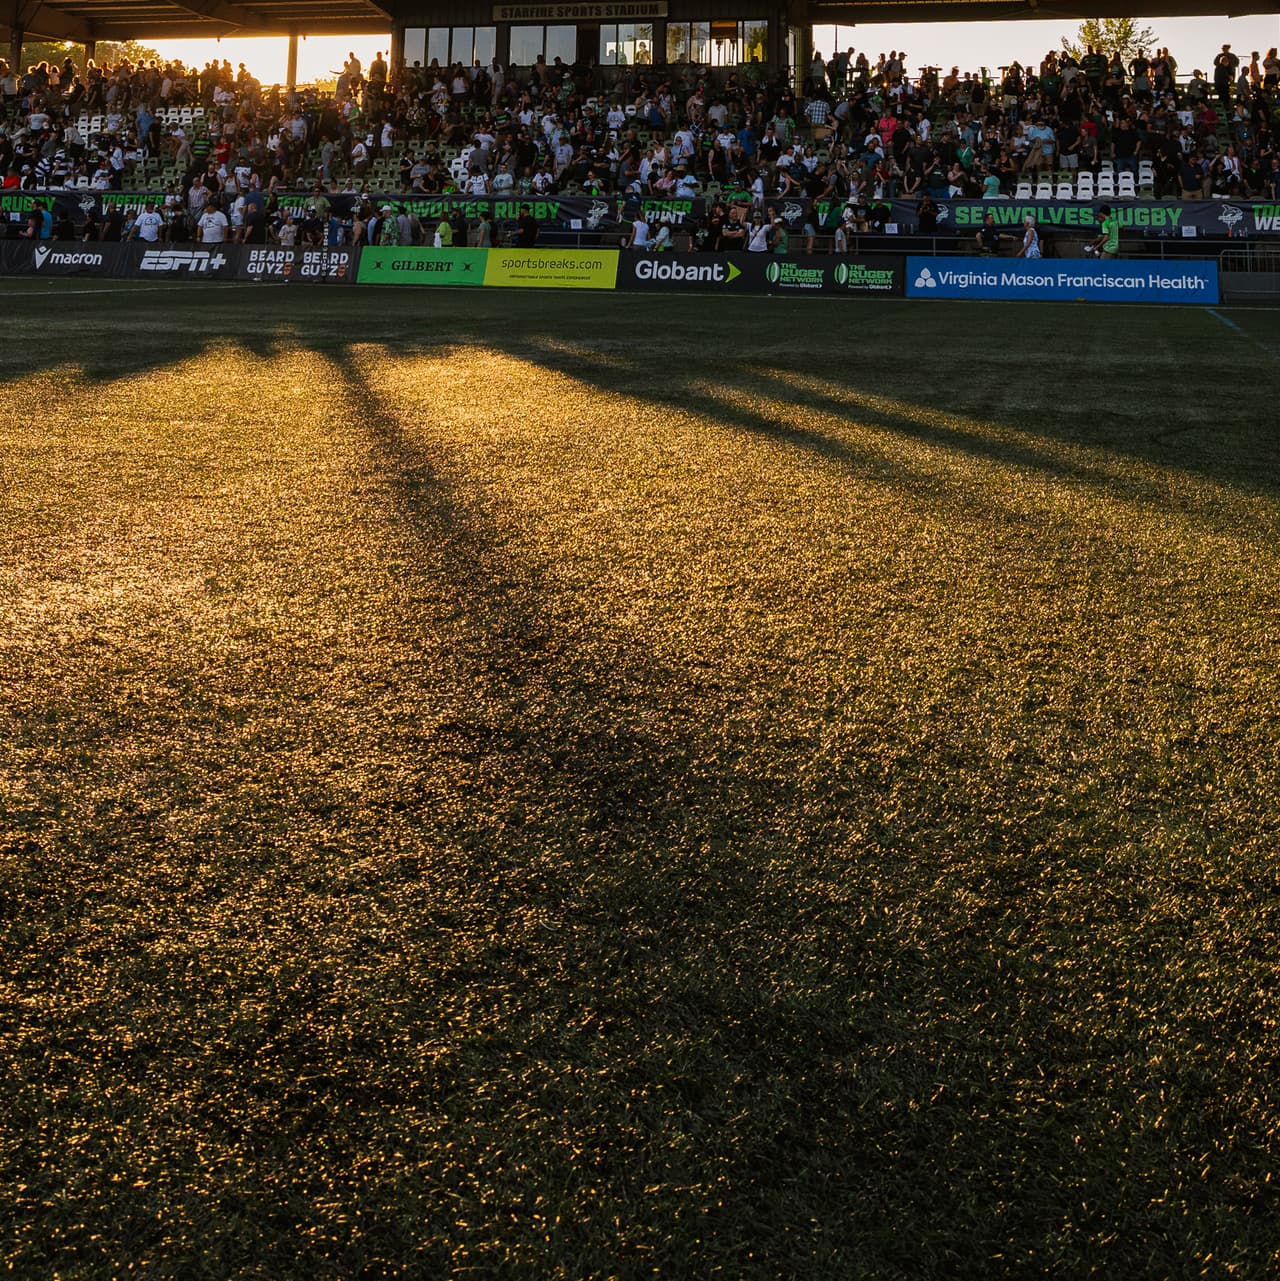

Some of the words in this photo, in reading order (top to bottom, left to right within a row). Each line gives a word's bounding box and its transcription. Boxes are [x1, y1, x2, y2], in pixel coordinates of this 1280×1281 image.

[501, 7, 556, 19] STARFIRE
[557, 5, 602, 18] SPORTS
[606, 4, 659, 16] STADIUM
[49, 252, 103, 265] macron
[139, 250, 227, 271] ESPN+
[249, 250, 295, 262] BEARD
[303, 252, 349, 264] BERD
[246, 262, 284, 274] GUYZ
[391, 260, 454, 272] GILBERT
[501, 258, 603, 270] sportsbreaks.com
[635, 260, 724, 282] Globant
[780, 268, 824, 277] RUGBY
[849, 270, 895, 279] RUGBY
[938, 271, 998, 288] Virginia
[1000, 272, 1055, 287] Mason
[1057, 274, 1145, 288] Franciscan
